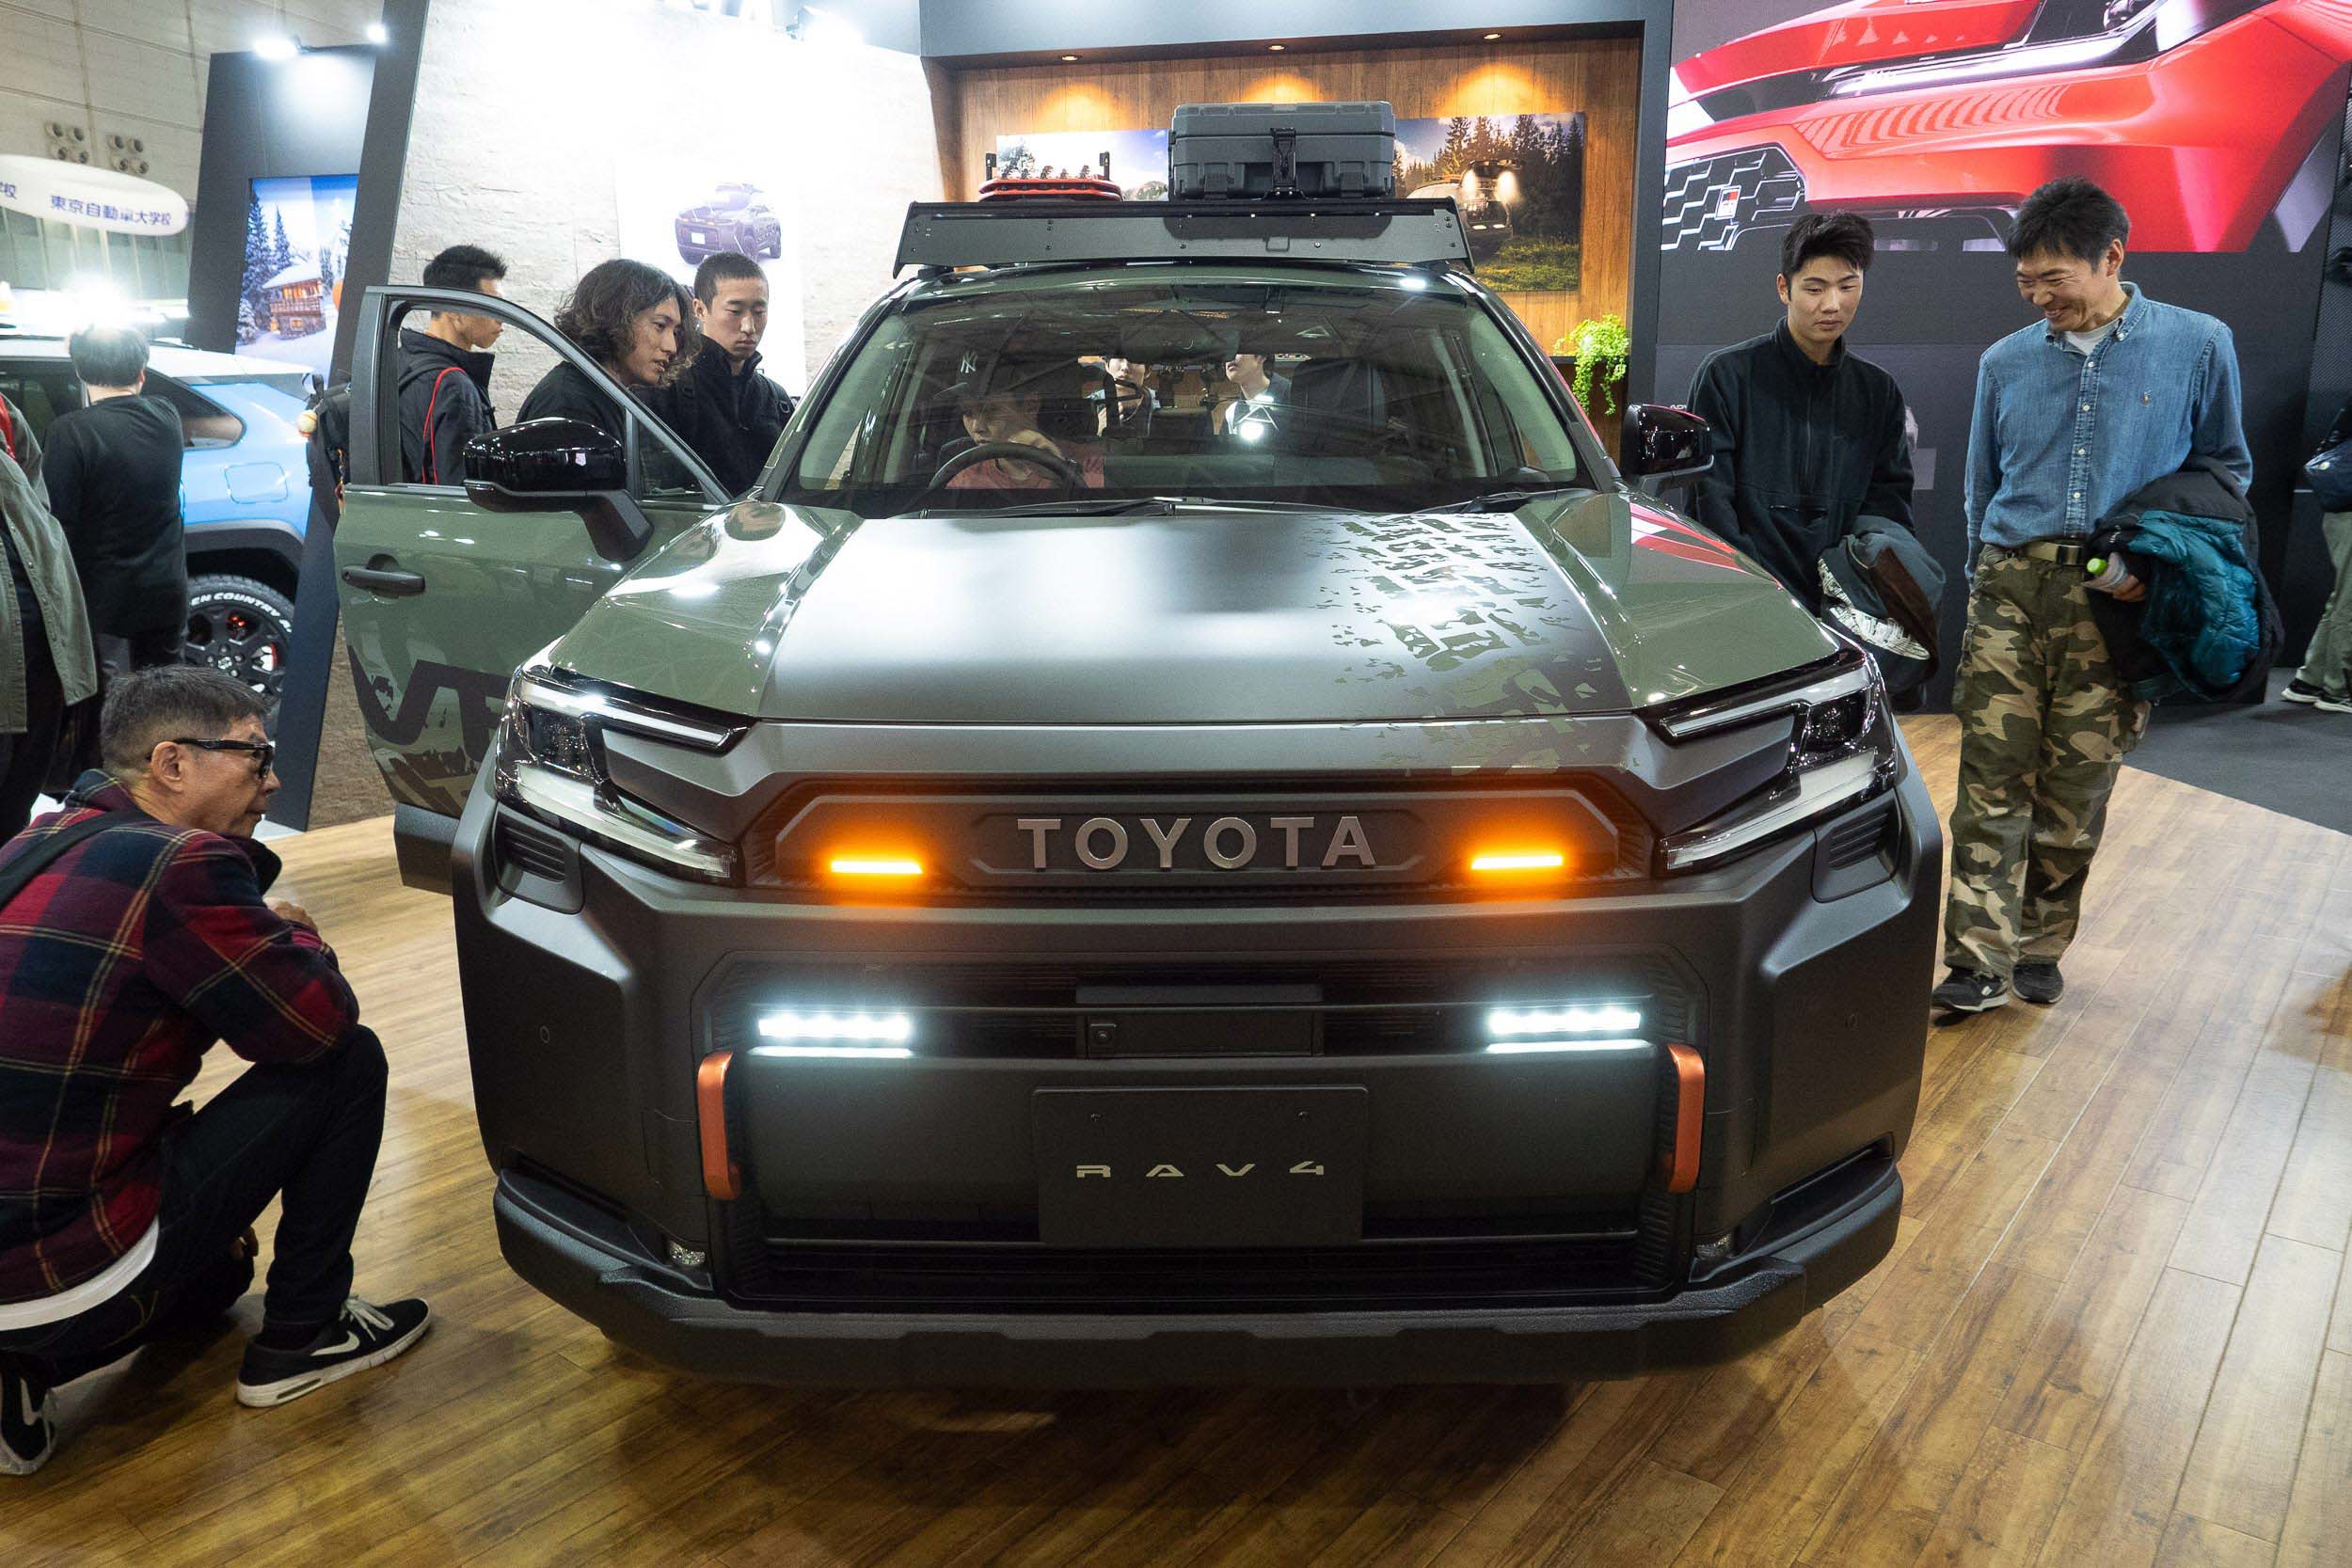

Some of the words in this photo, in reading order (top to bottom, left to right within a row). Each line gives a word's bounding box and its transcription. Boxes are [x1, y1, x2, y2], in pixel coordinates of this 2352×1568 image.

[51, 195, 172, 227] 東京自動車大学校
[214, 592, 280, 617] COUNTRY
[1017, 816, 1377, 871] TOYOTA
[1076, 1161, 1325, 1178] RAV4
